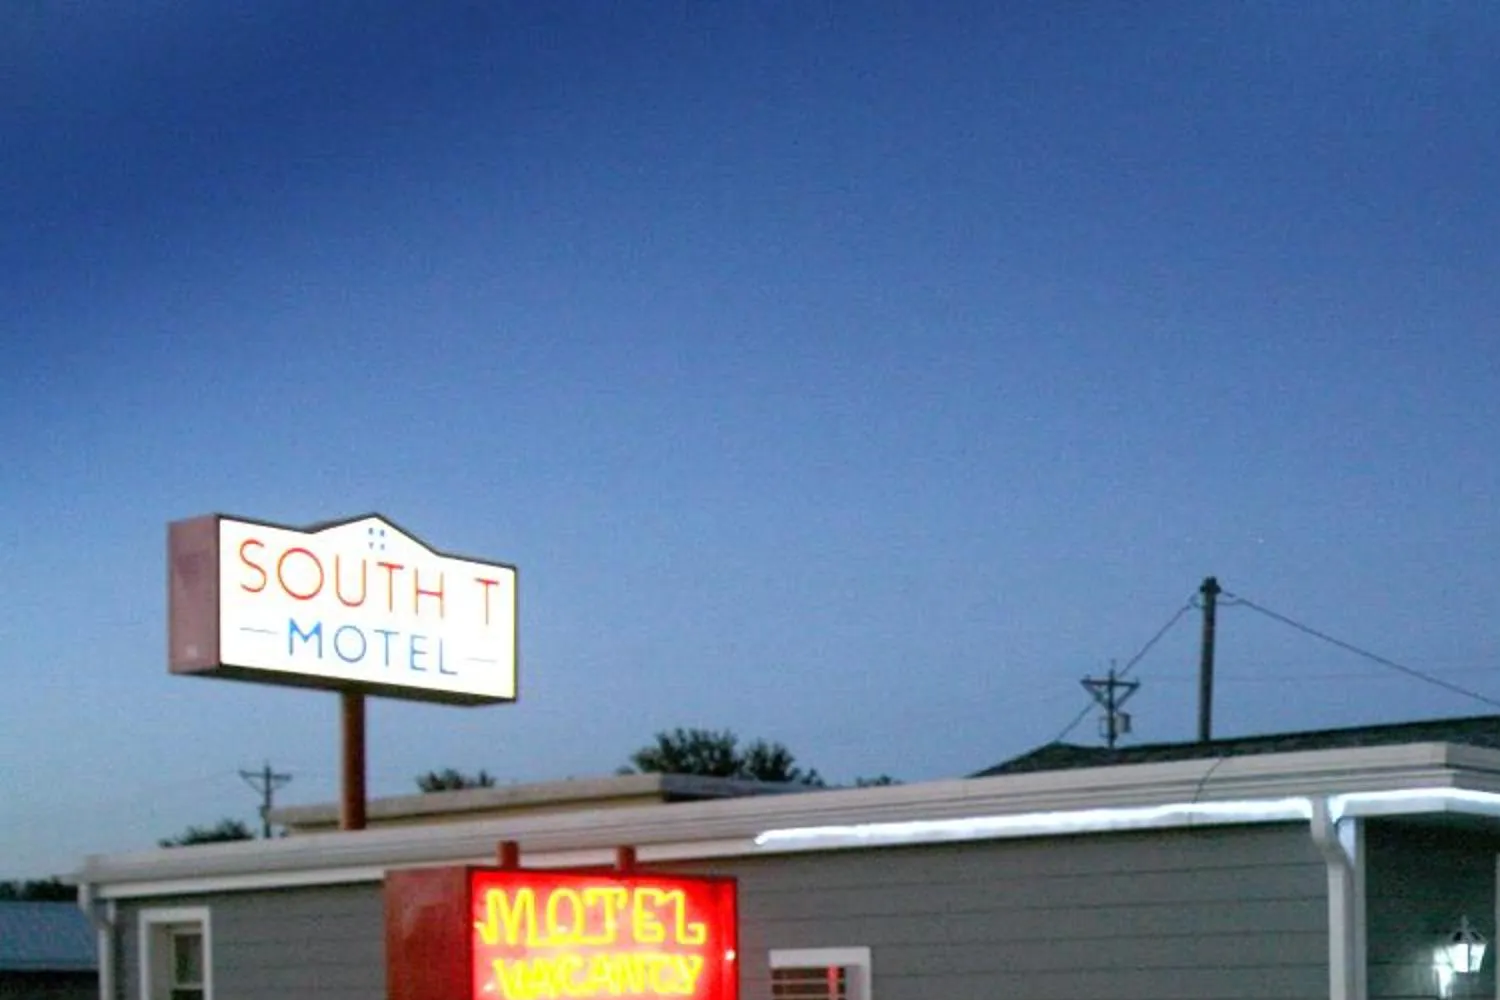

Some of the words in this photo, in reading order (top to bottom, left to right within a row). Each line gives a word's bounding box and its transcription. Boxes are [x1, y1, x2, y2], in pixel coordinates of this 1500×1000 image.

[239, 538, 444, 619] SOUTH
[474, 577, 499, 626] T
[288, 617, 458, 676] MOTEL
[475, 887, 708, 946] MOTEL
